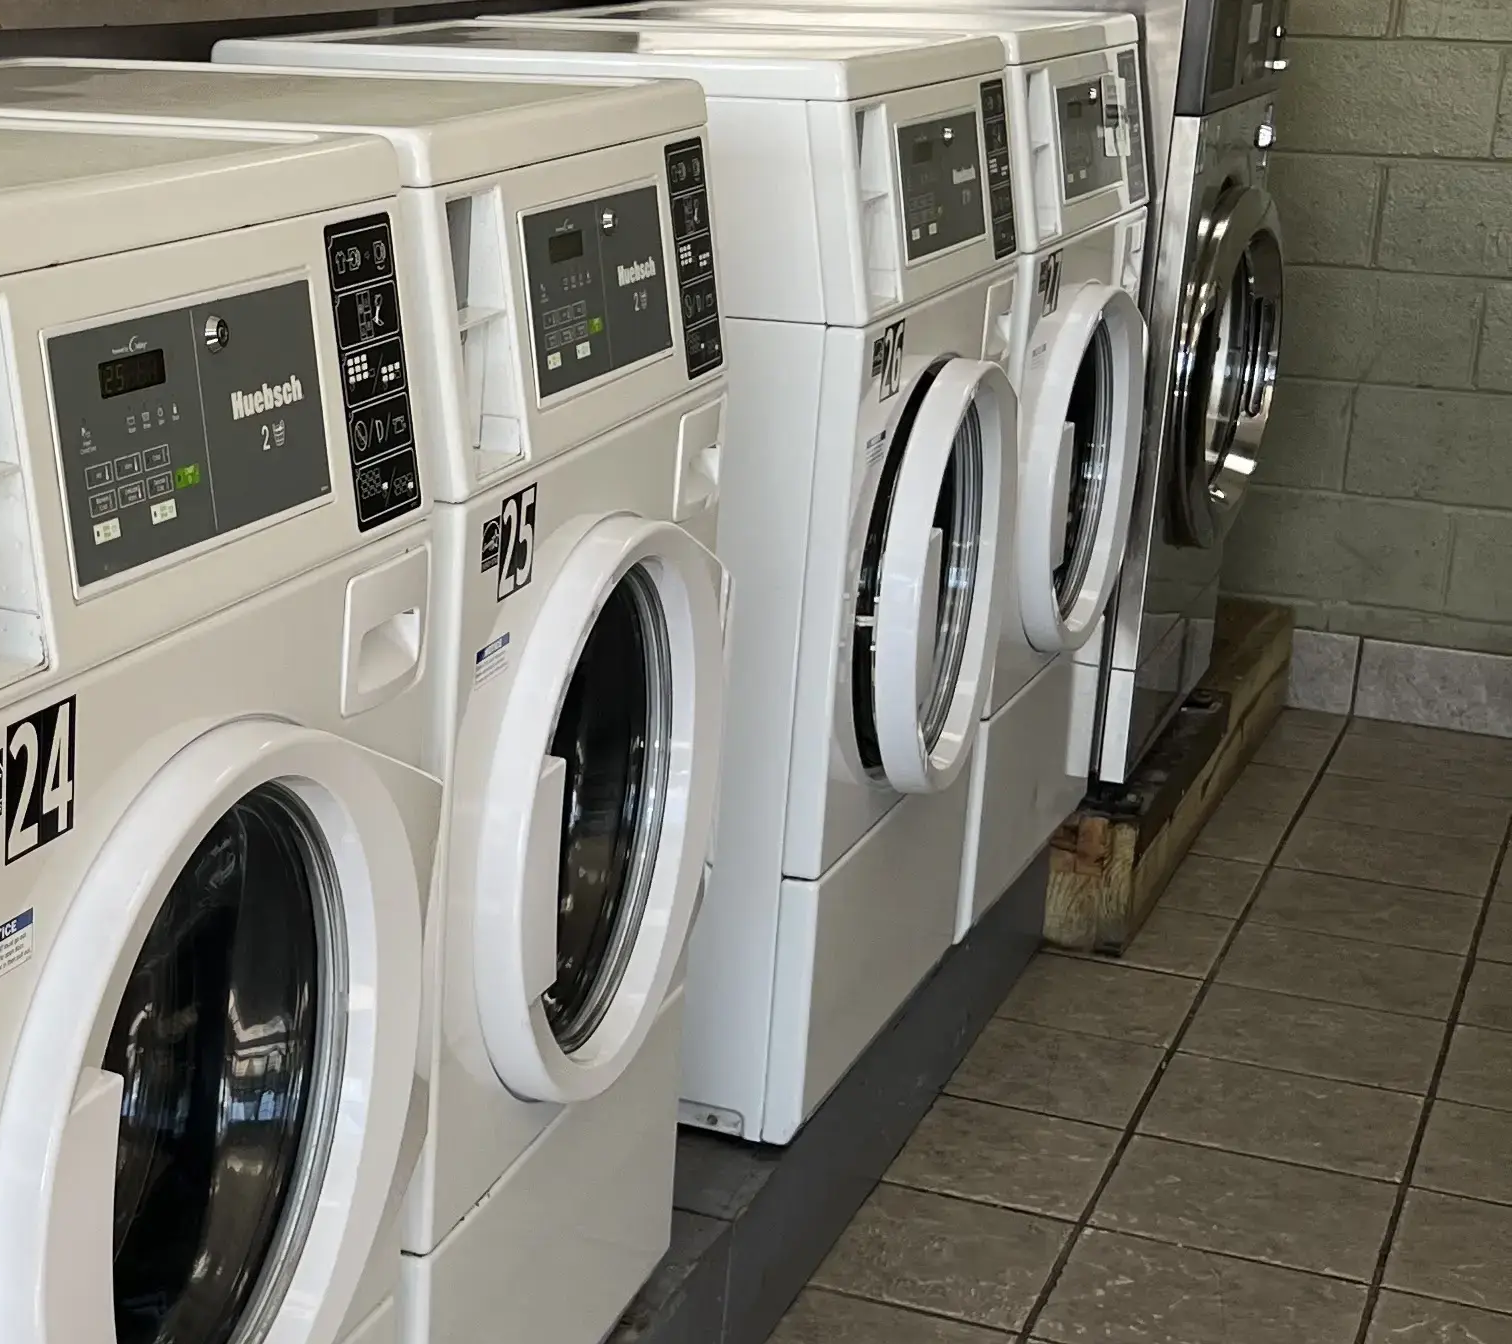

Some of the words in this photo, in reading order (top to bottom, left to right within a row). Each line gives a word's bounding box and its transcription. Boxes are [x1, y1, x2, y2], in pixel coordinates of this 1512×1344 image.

[231, 375, 303, 420] Huebsch
[880, 322, 904, 401] 26
[261, 425, 270, 450] 2
[499, 487, 535, 599] 25
[7, 702, 73, 860] 24
